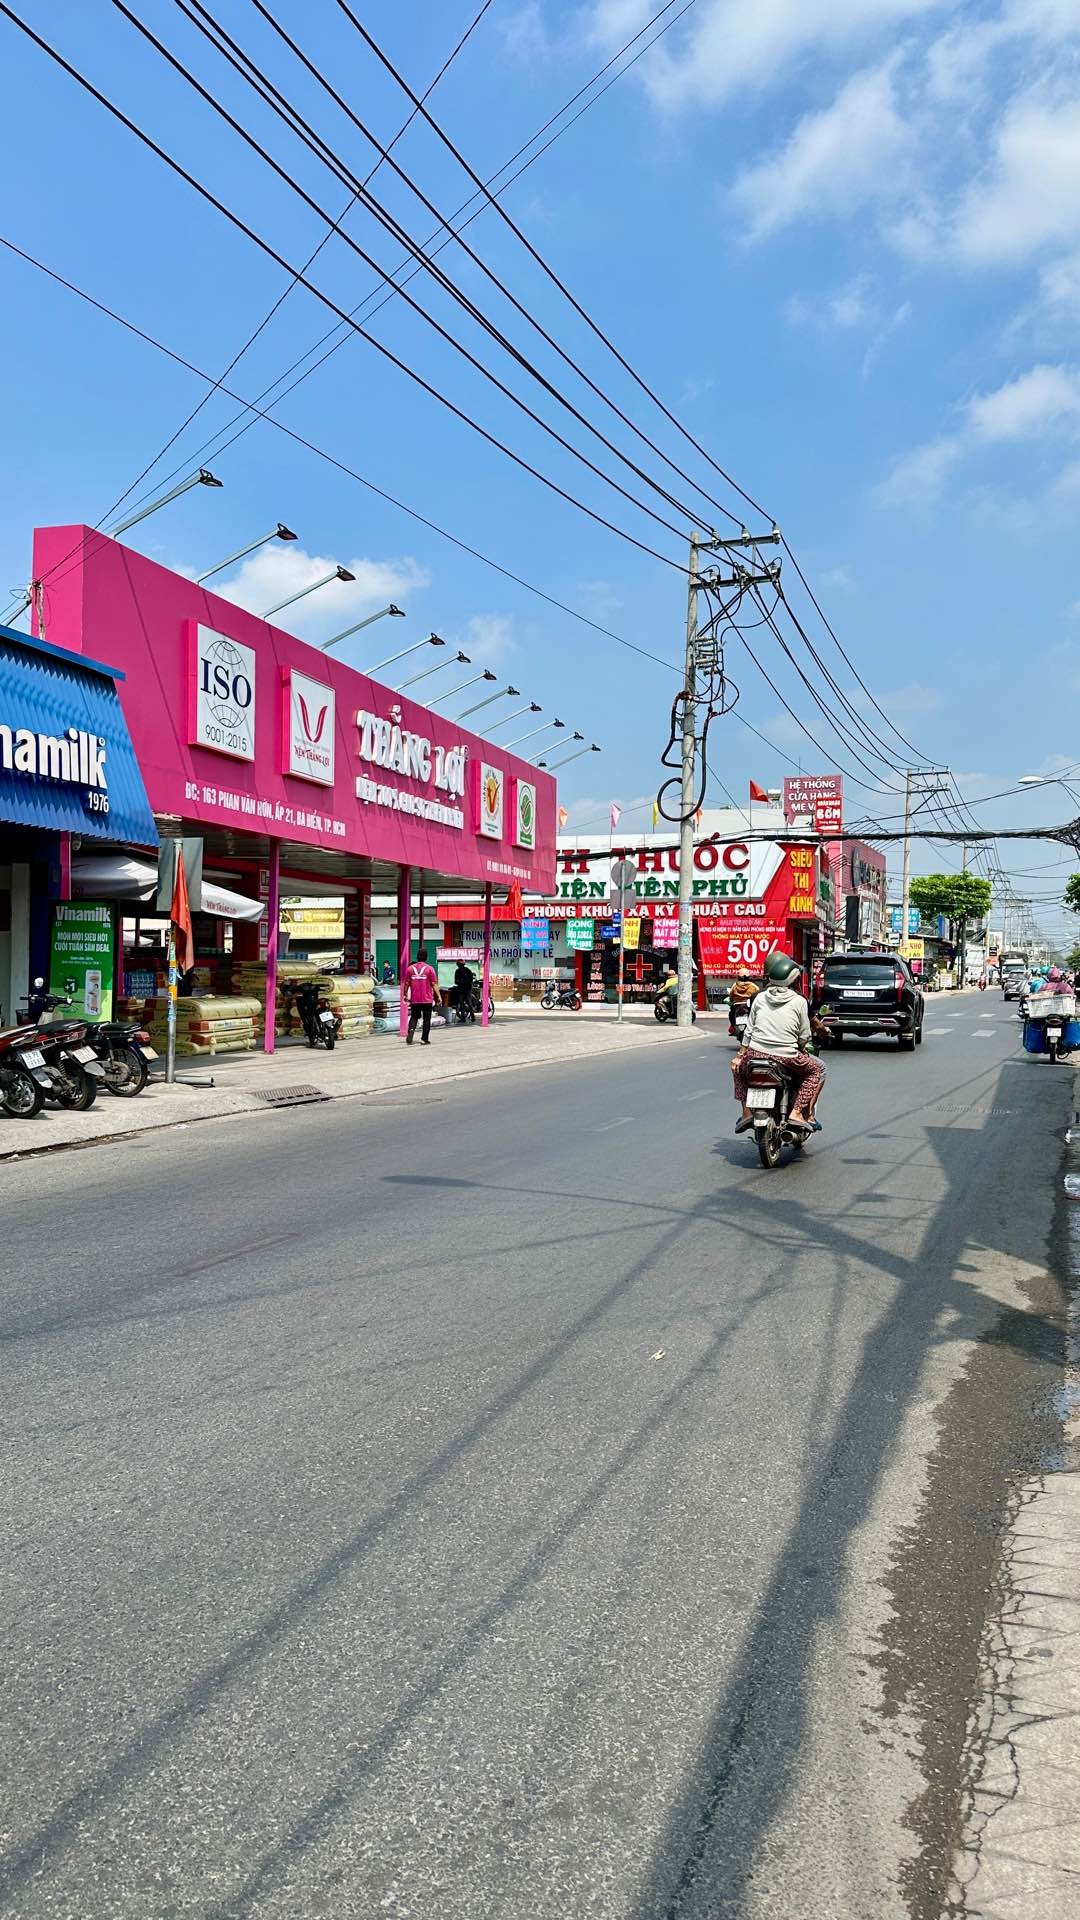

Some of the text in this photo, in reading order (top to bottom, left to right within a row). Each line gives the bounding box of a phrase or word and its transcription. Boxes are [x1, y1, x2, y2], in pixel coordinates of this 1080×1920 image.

[200, 657, 252, 708] ISO
[205, 724, 247, 752] 9001:2015
[356, 704, 465, 800] THẮNG LỢI
[803, 776, 836, 789] THỐNG
[88, 792, 109, 812] 1976
[202, 786, 216, 805] 163
[218, 790, 240, 811] PHAN
[241, 794, 256, 815] VĂN
[789, 790, 808, 801] CỬA
[790, 848, 812, 868] SIÊU
[556, 872, 748, 900] IỆN IÊN PHỦ
[793, 872, 809, 893] THỊ
[524, 904, 576, 918] PHÒNG
[580, 902, 617, 918] KHÚ
[628, 904, 650, 918] XẠ
[655, 902, 675, 916] KỸ
[691, 902, 729, 918] HUẬT
[734, 904, 766, 916] CAO
[790, 893, 812, 913] KÍNH
[56, 906, 110, 921] Vinamilk
[656, 918, 679, 926] KÍNH
[96, 944, 109, 952] DEAL
[502, 945, 522, 958] PHỐI
[728, 939, 778, 963] 50%
